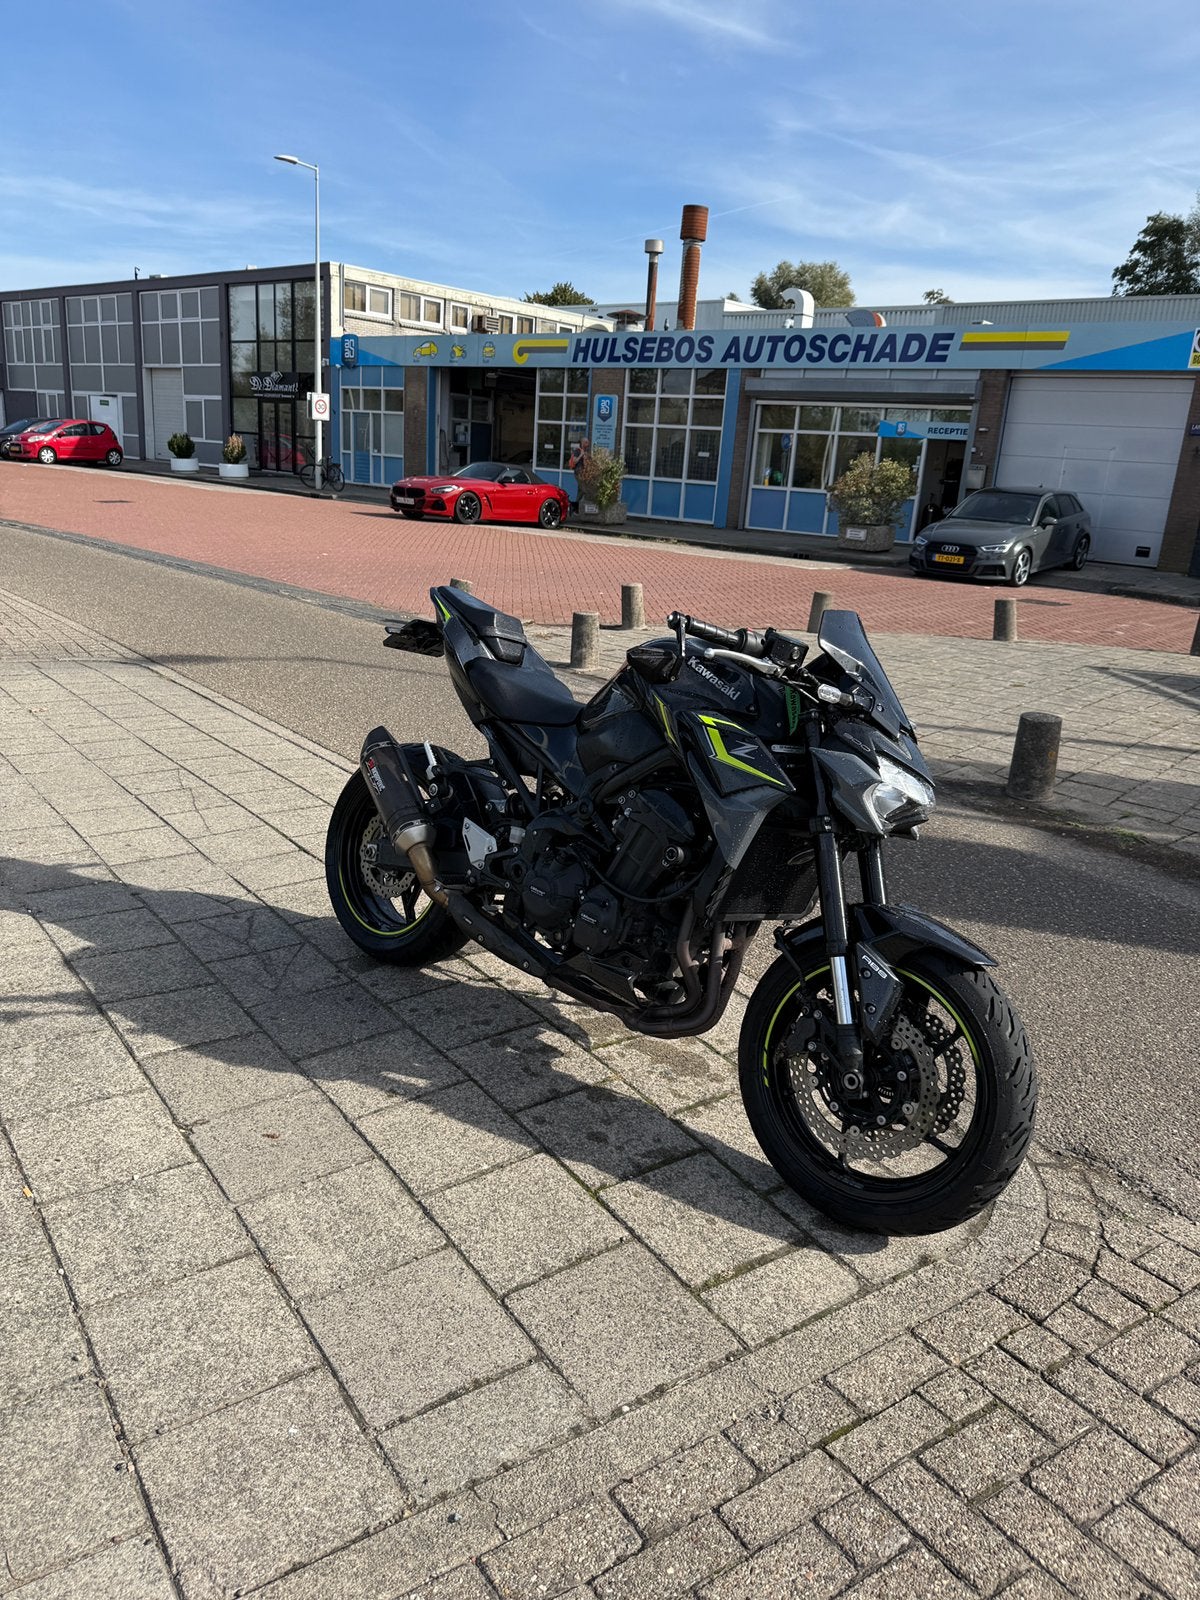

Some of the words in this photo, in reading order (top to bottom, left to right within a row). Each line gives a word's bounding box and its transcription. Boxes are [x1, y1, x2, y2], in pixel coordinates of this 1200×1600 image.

[572, 335, 715, 363] HULSEBOS
[720, 332, 955, 363] AUTOSCHADE
[927, 427, 969, 436] RECEPTIE
[687, 656, 741, 701] Kawasaki
[861, 955, 888, 979] ABS
